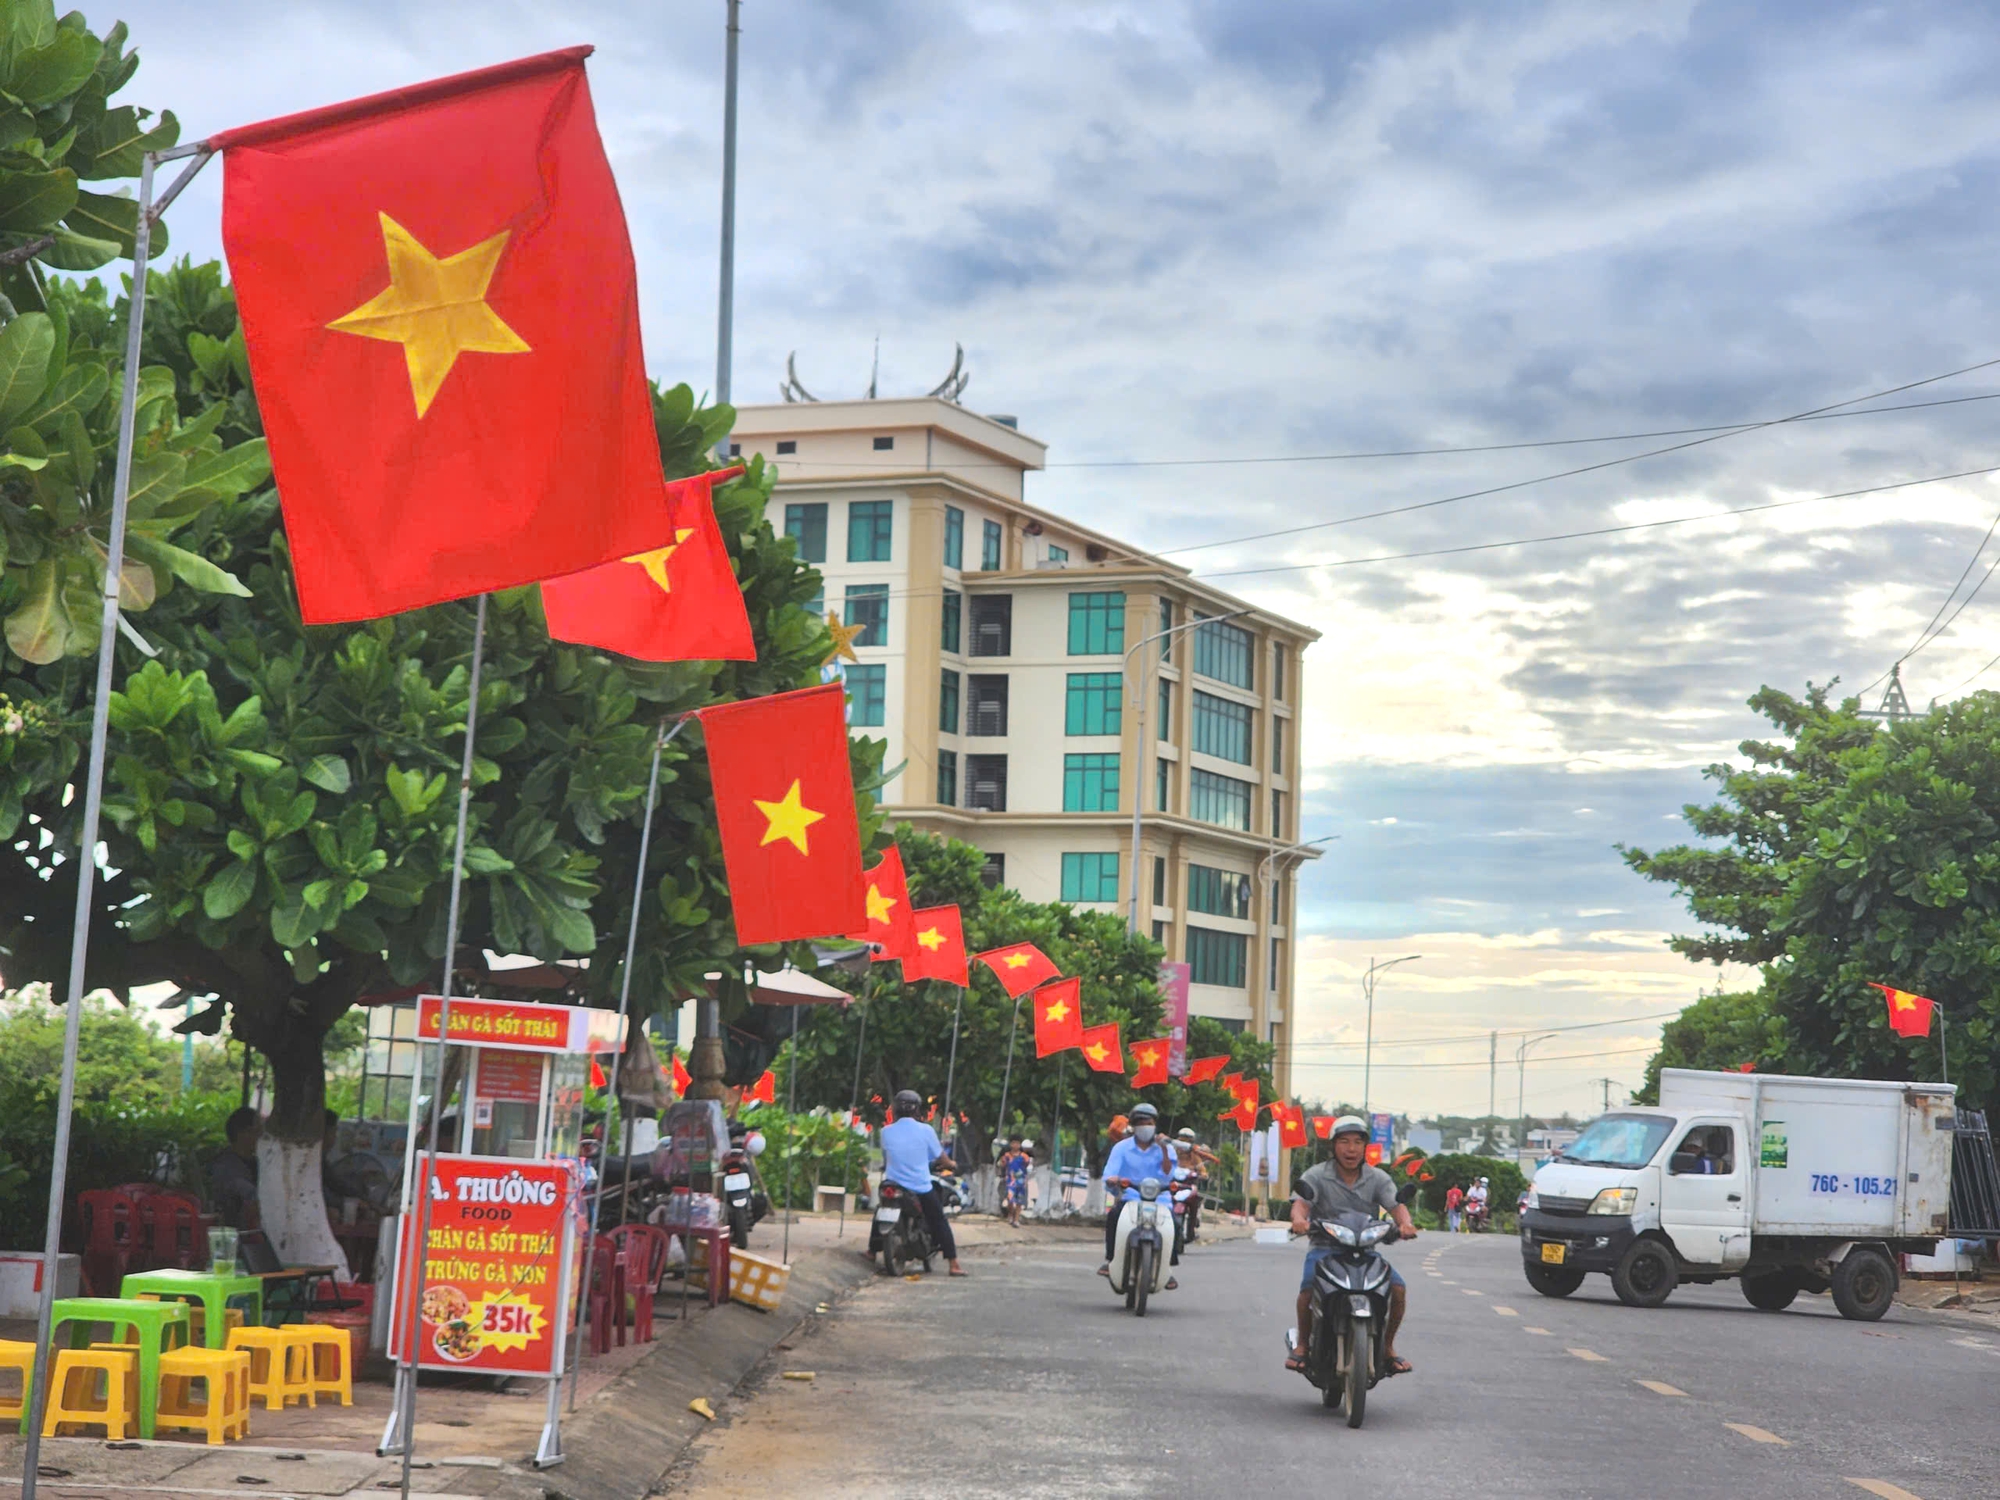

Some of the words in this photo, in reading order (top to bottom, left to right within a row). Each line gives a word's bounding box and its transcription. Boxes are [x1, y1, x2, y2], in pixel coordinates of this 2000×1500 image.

[431, 1010, 470, 1031] CÂN
[472, 1011, 492, 1033] GÀ
[495, 1011, 521, 1035] SỐT
[524, 1016, 558, 1038] THÁI
[456, 1169, 557, 1206] THƯỞNG
[1811, 1174, 1839, 1193] 76C
[1854, 1176, 1898, 1196] 105.21
[461, 1206, 513, 1221] FOOD
[427, 1224, 463, 1249] HÂN
[465, 1226, 486, 1251] GÀ
[489, 1224, 518, 1252] SỐT
[520, 1229, 555, 1255] THÁI
[484, 1258, 507, 1283] GÀ
[511, 1264, 547, 1285] NON
